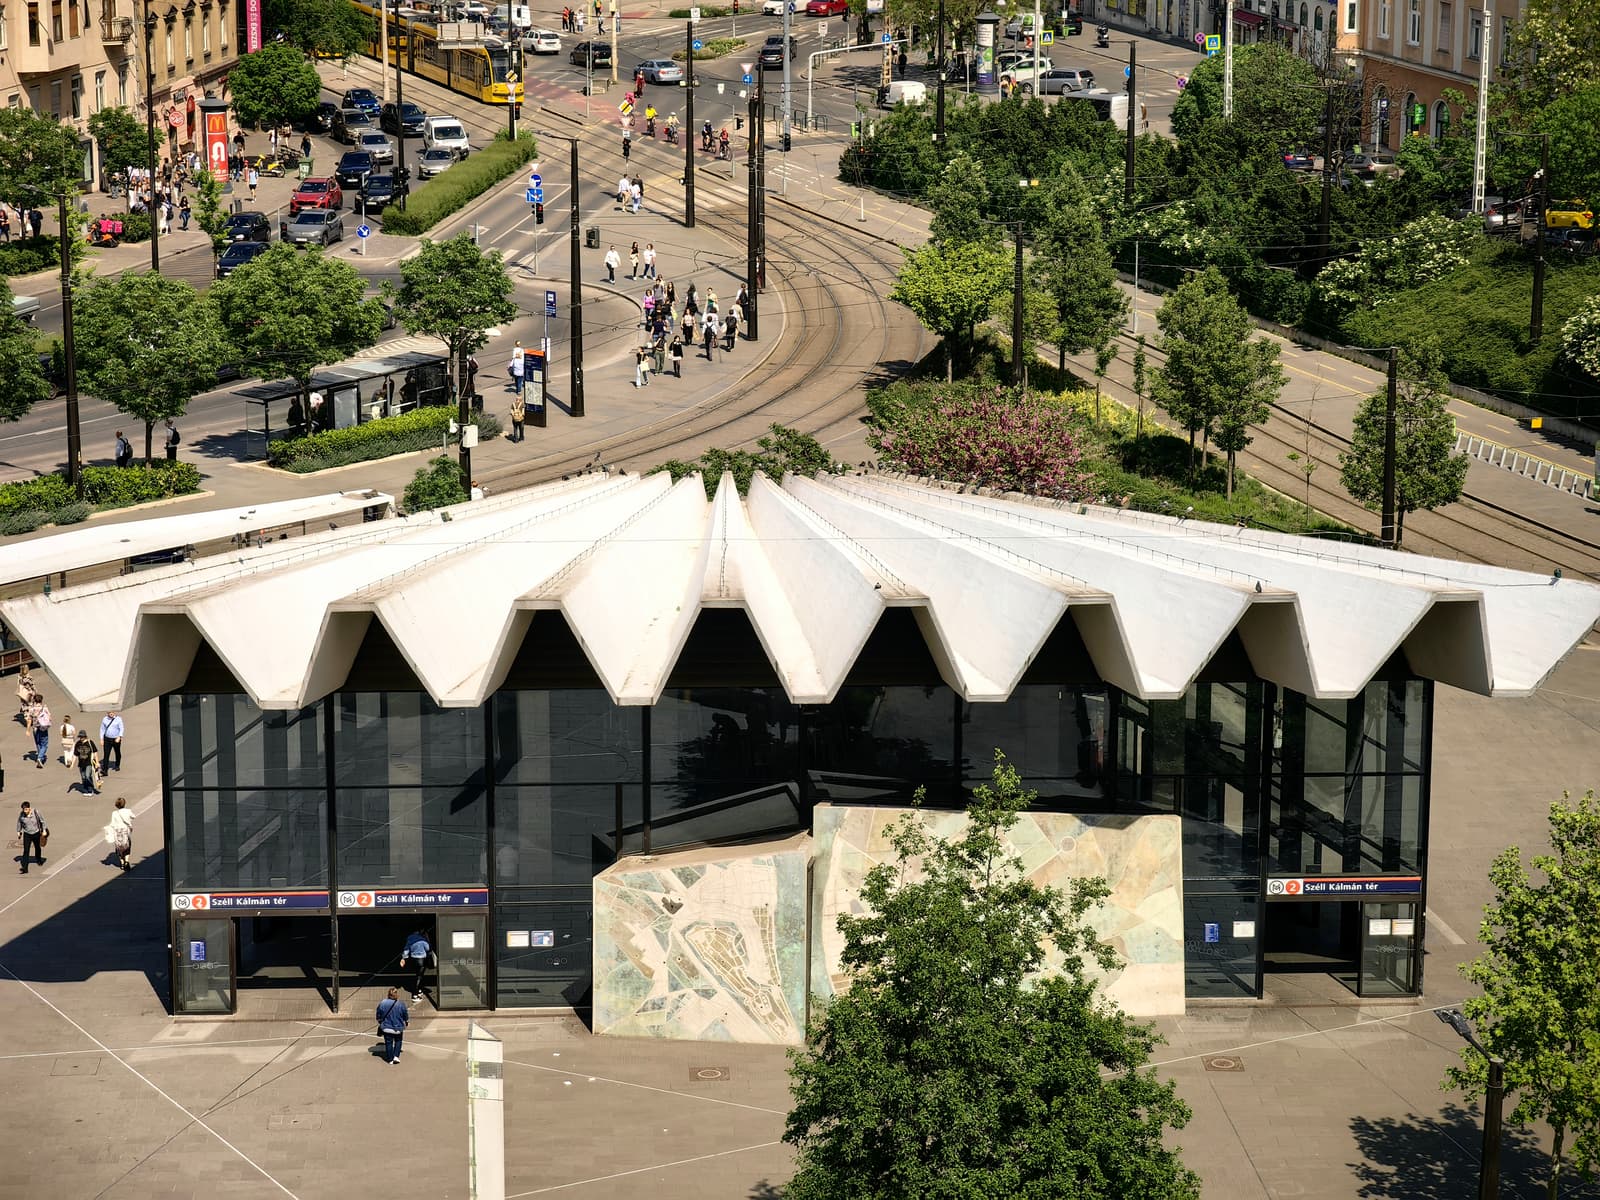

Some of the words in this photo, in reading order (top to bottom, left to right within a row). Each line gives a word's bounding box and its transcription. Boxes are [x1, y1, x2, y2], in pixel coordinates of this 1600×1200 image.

[1305, 882, 1326, 891] Széll
[1329, 882, 1363, 891] Kálmán
[1365, 882, 1379, 891] tér
[212, 898, 233, 906] Széll
[236, 897, 271, 905] Kálmán
[273, 897, 287, 905] tér
[377, 895, 398, 903] Széll
[401, 894, 435, 903] Kálmán
[438, 894, 452, 902] tér
